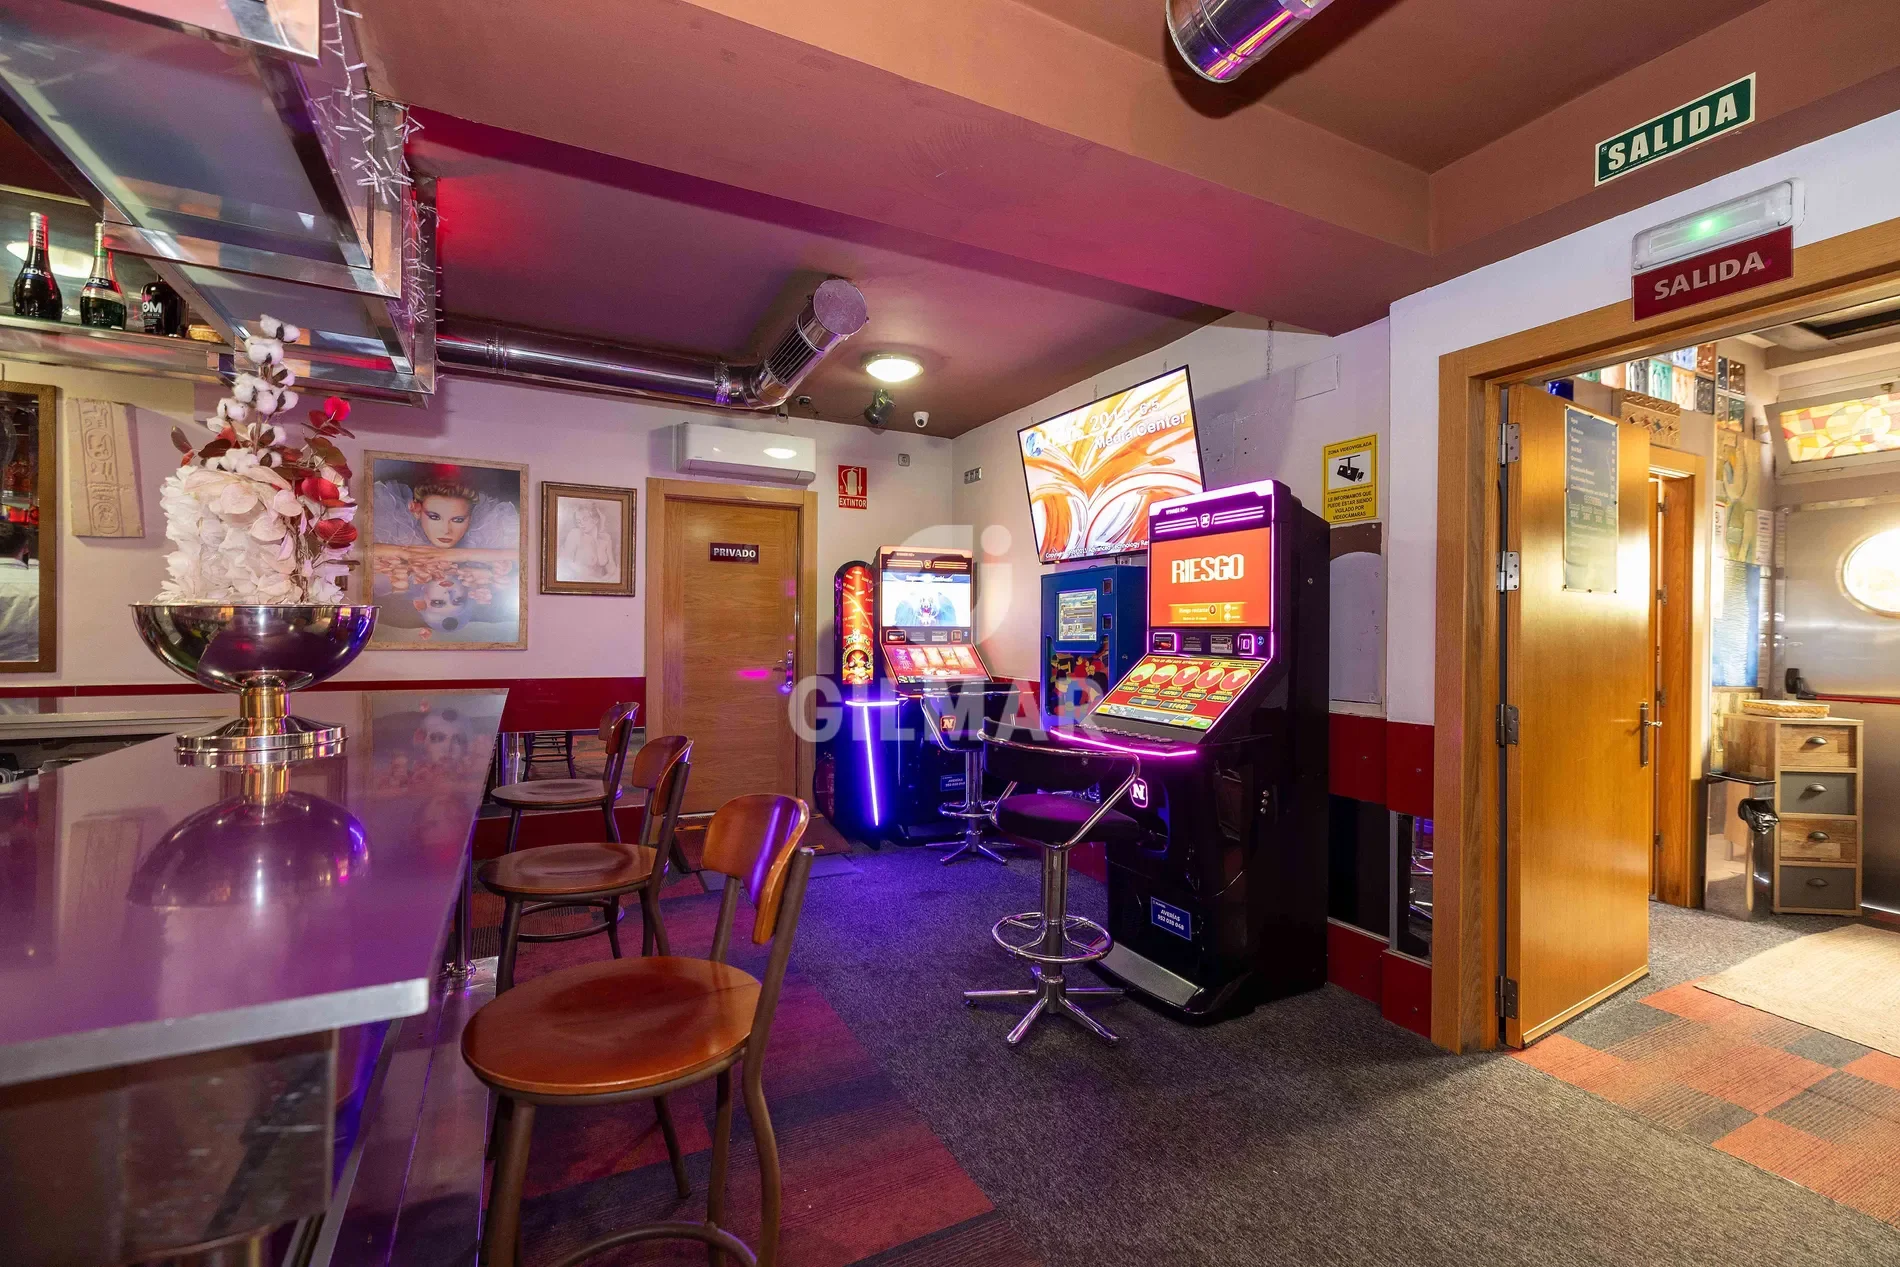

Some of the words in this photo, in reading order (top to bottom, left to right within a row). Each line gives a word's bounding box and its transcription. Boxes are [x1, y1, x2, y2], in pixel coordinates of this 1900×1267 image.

[1608, 92, 1738, 171] SALIDA
[1654, 250, 1766, 301] SALIDA
[1096, 428, 1136, 450] Media
[1136, 411, 1188, 437] Center
[1339, 441, 1372, 453] VIDEOVIGILADA
[1333, 492, 1362, 501] INFORMAMOS
[1356, 497, 1373, 505] SIENDO
[839, 497, 867, 508] EXTINTOR
[1334, 506, 1354, 514] VIGILADO
[713, 547, 757, 558] PRIVADO
[1171, 553, 1245, 584] RIESGO
[942, 719, 955, 729] N
[1132, 783, 1145, 800] N
